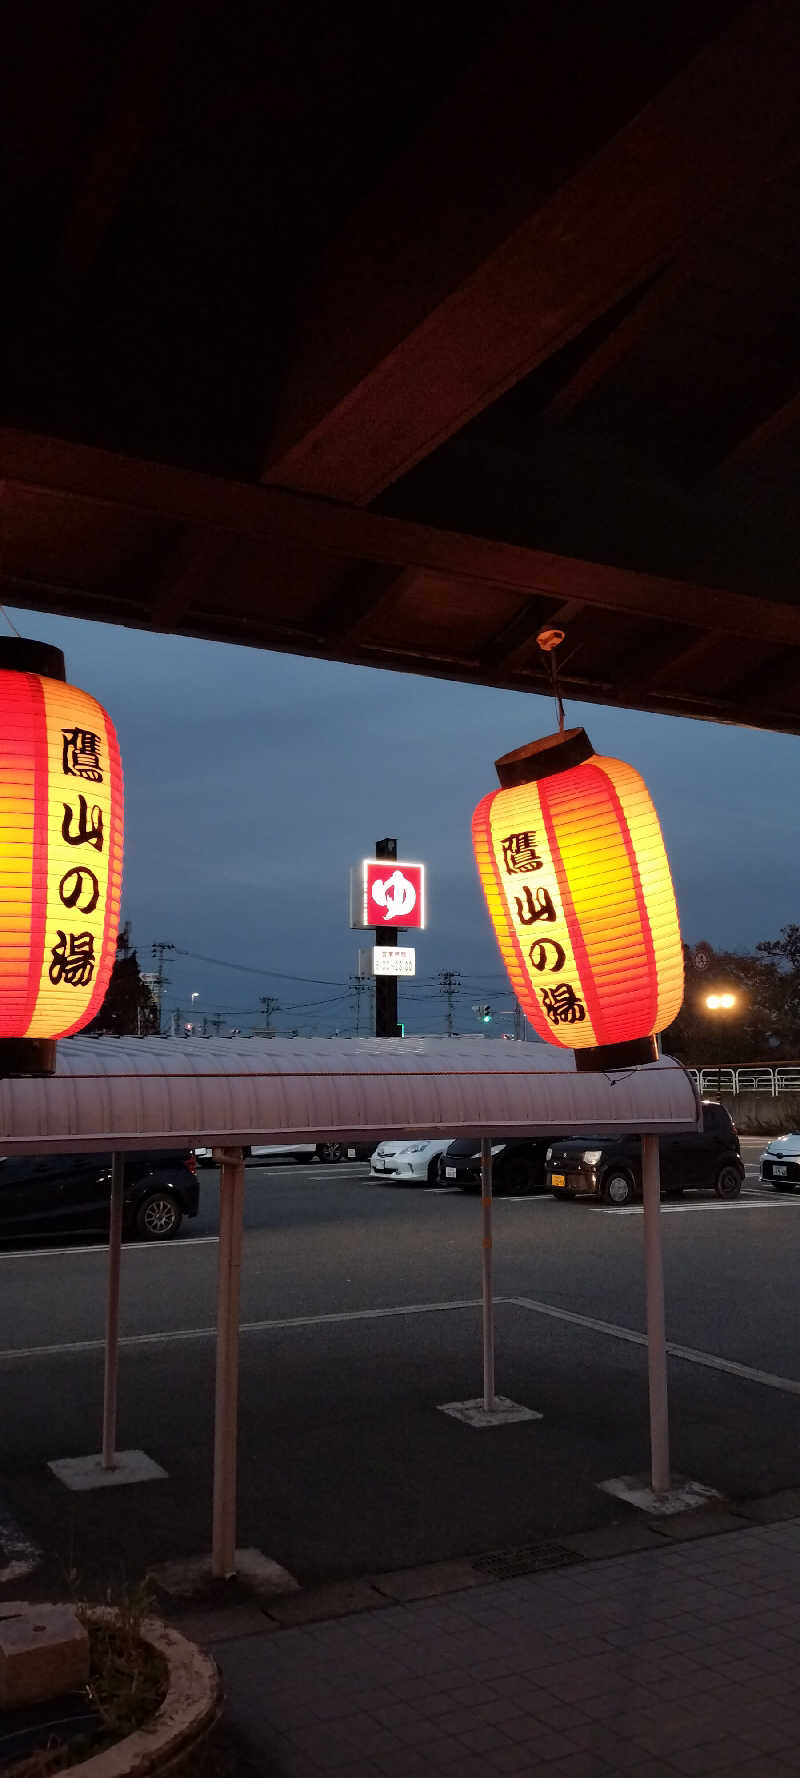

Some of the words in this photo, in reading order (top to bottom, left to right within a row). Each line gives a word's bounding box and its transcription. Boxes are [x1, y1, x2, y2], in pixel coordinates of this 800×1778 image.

[49, 727, 104, 987] 鷹山の湯
[371, 870, 417, 921] ゆ
[500, 830, 586, 1026] 鷹山の湯
